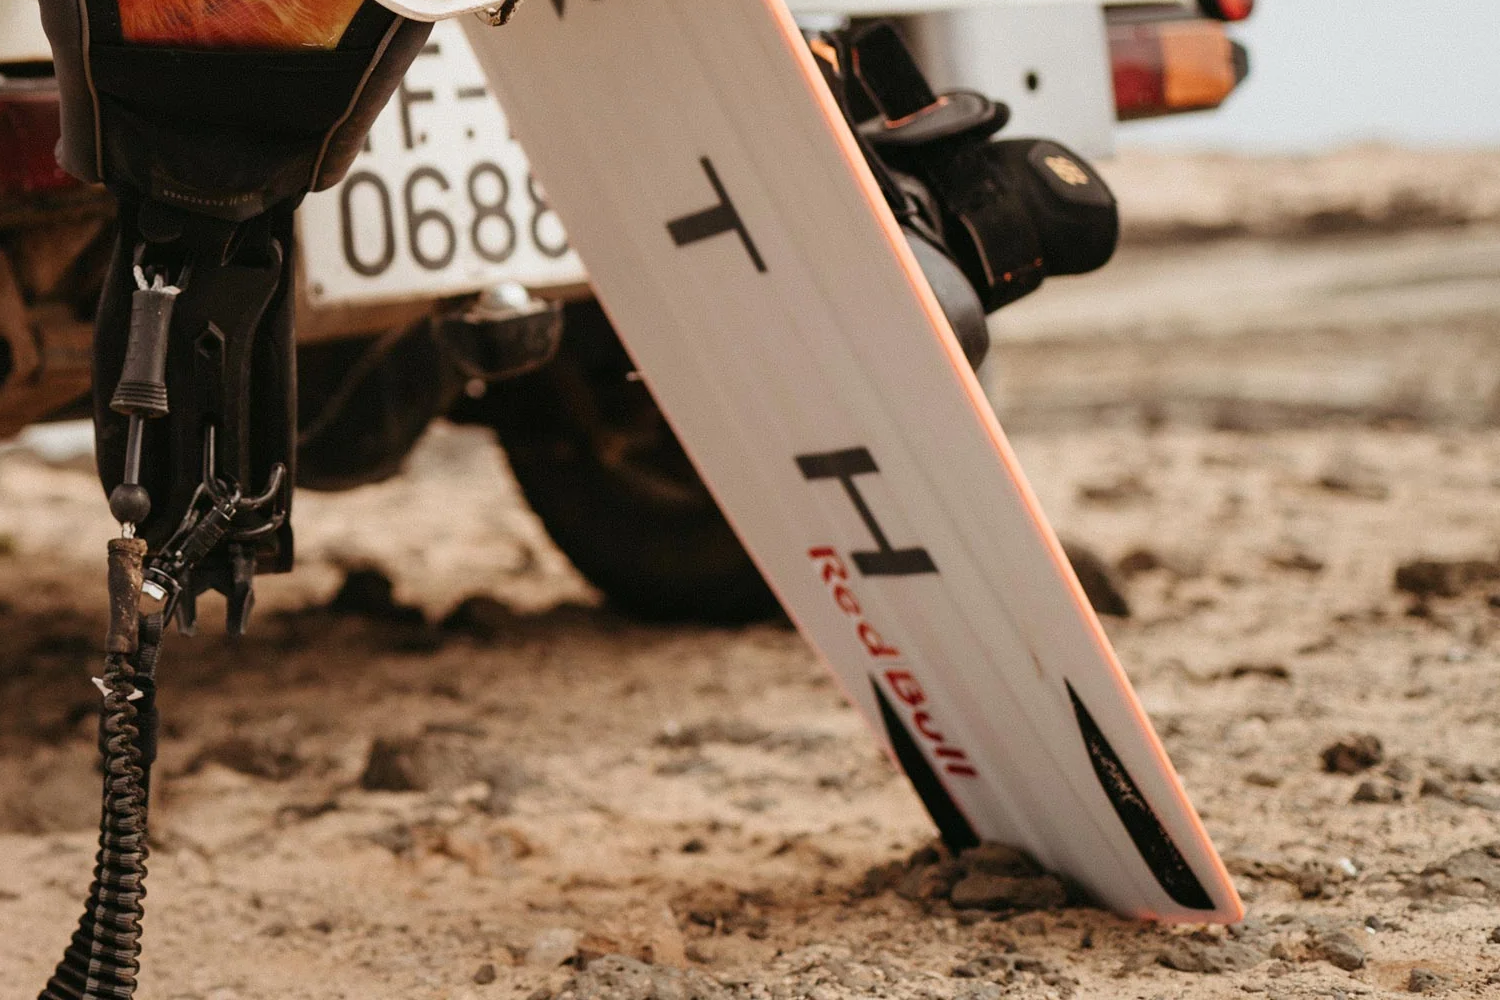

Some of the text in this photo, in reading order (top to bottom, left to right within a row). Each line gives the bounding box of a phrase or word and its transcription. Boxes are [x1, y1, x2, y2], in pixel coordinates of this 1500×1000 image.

[340, 162, 569, 277] 0688
[808, 546, 978, 778] Red Bull
